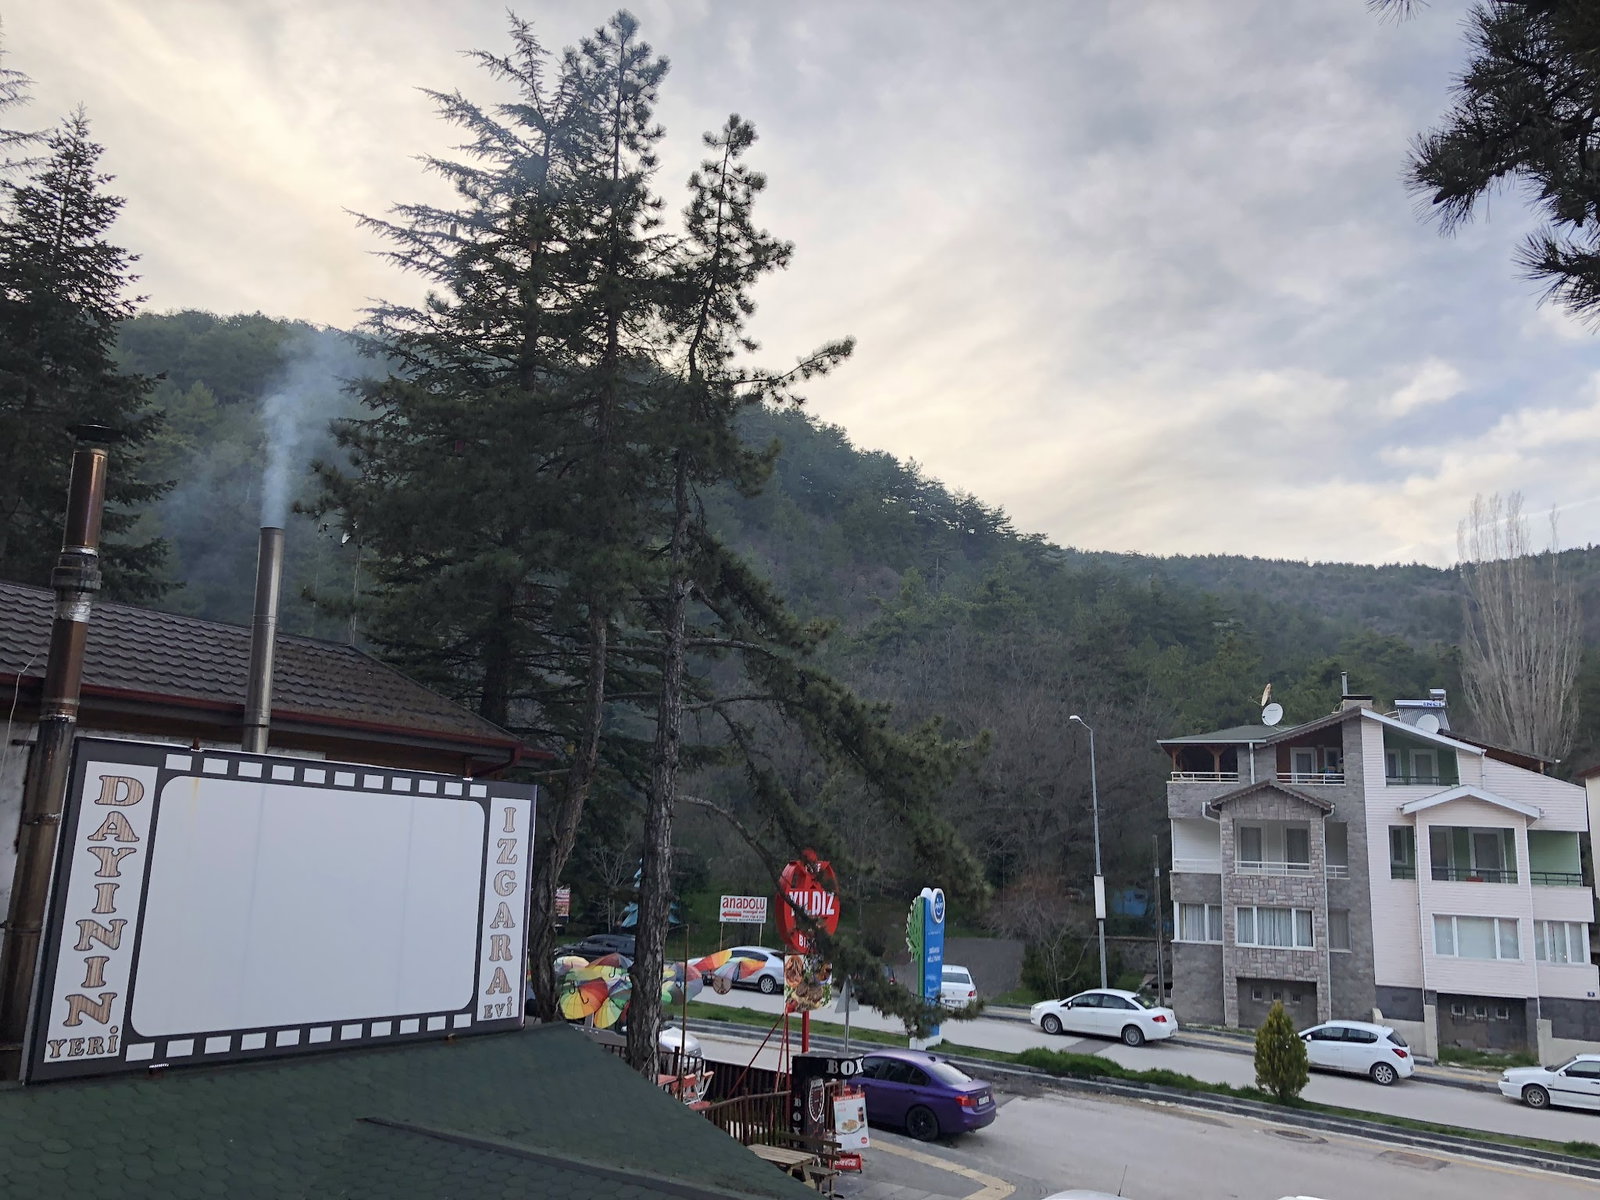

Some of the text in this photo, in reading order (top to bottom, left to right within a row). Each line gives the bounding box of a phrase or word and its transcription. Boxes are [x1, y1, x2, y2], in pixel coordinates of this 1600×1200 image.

[63, 774, 145, 1027] DAYININ
[485, 806, 518, 995] IZGARA
[47, 1025, 119, 1059] YERİ
[826, 1058, 864, 1076] BOX
